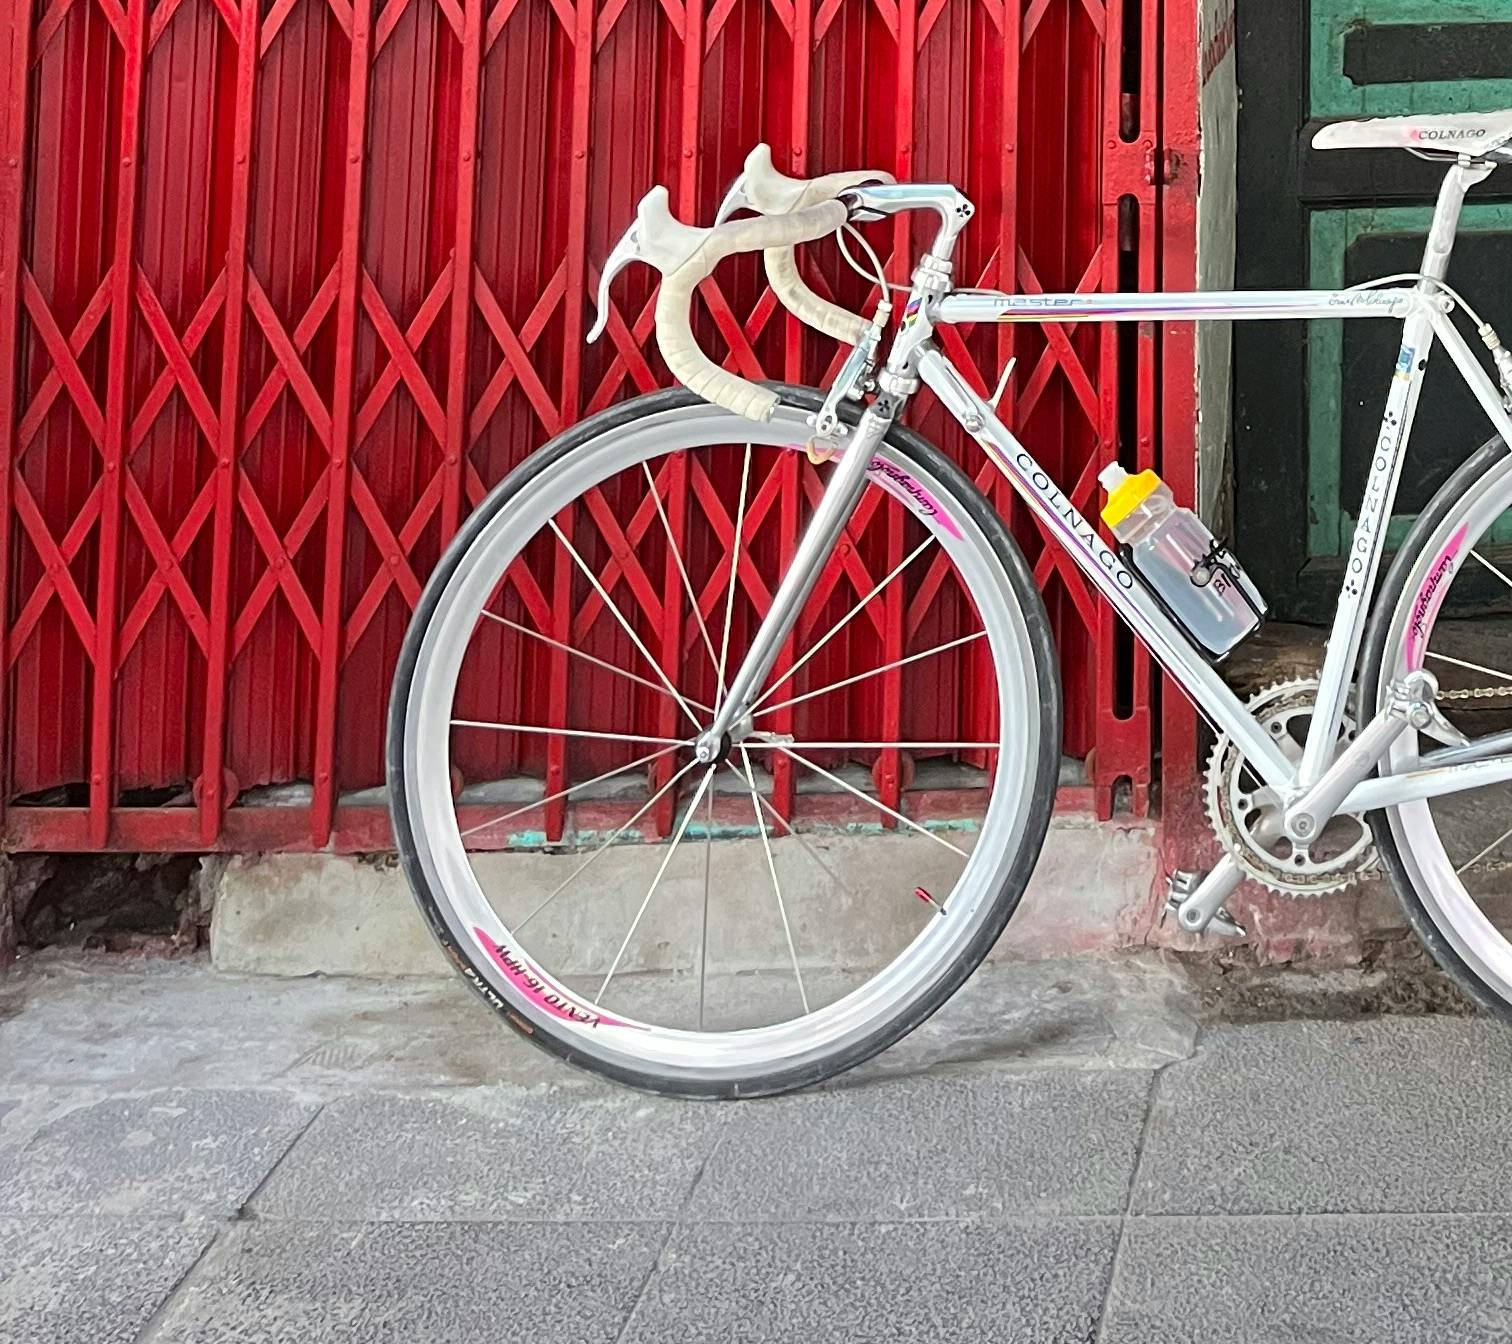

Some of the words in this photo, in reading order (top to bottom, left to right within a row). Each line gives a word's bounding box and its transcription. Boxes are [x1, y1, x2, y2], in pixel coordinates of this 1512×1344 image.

[1418, 128, 1486, 141] COLNAGO
[1016, 453, 1133, 589] COLNAGO
[1352, 435, 1392, 574] COLNAGO
